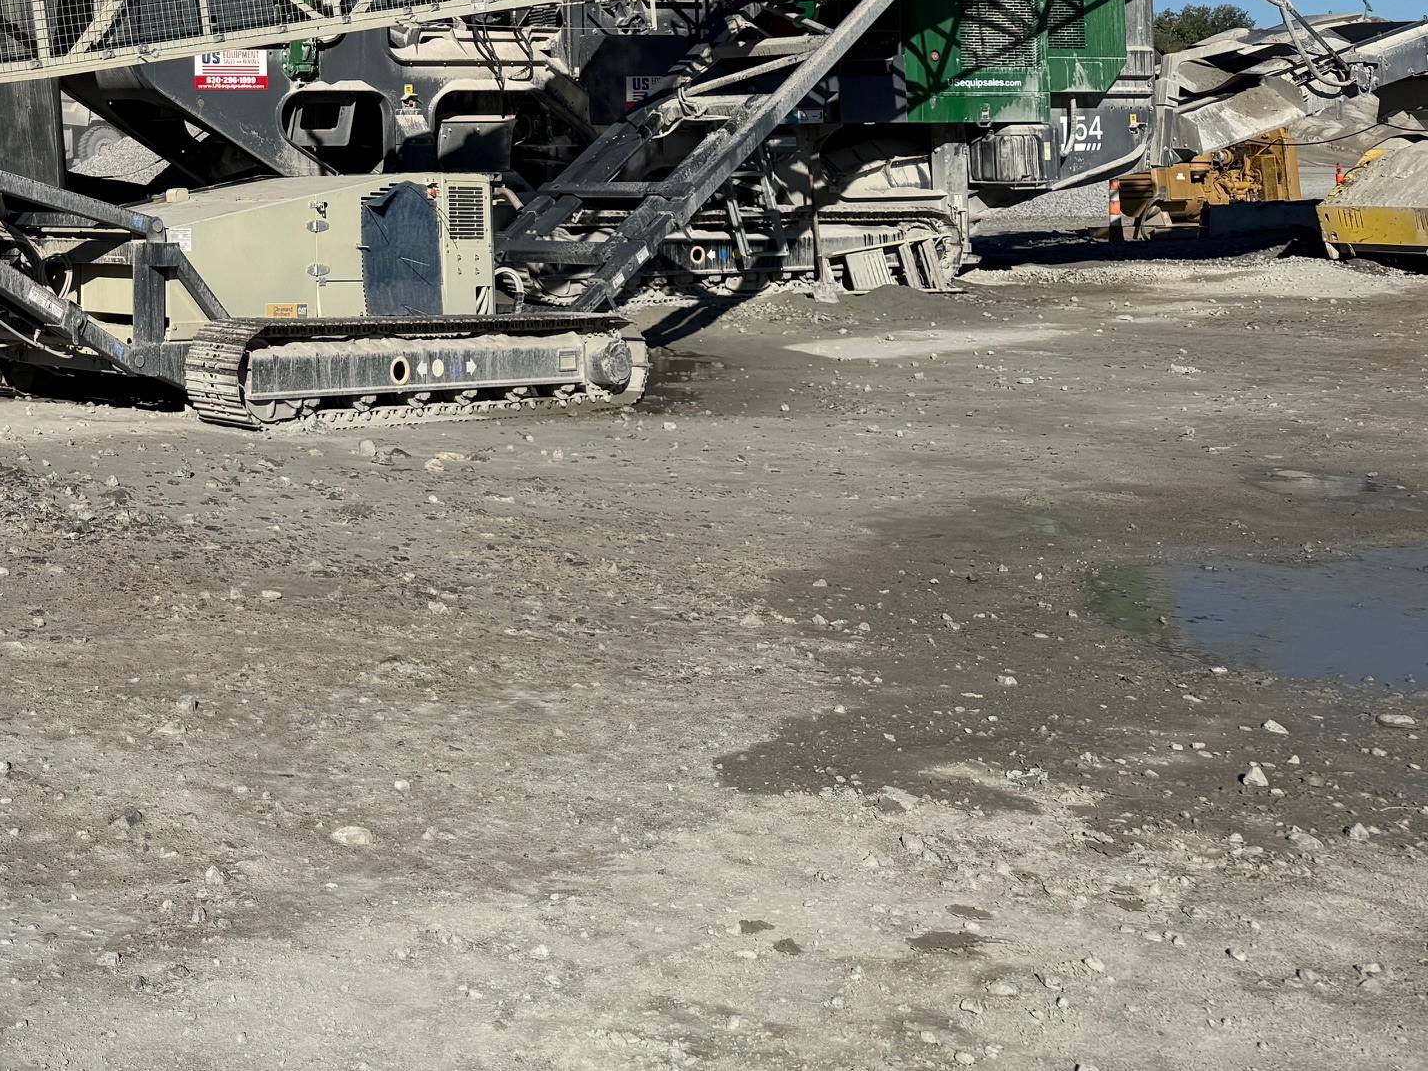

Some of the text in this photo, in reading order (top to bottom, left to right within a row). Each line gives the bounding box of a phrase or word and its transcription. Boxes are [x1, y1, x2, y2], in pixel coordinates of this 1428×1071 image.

[202, 50, 259, 64] US EQUIPMENT
[633, 77, 649, 90] US
[947, 78, 1022, 88] USequipsales.com
